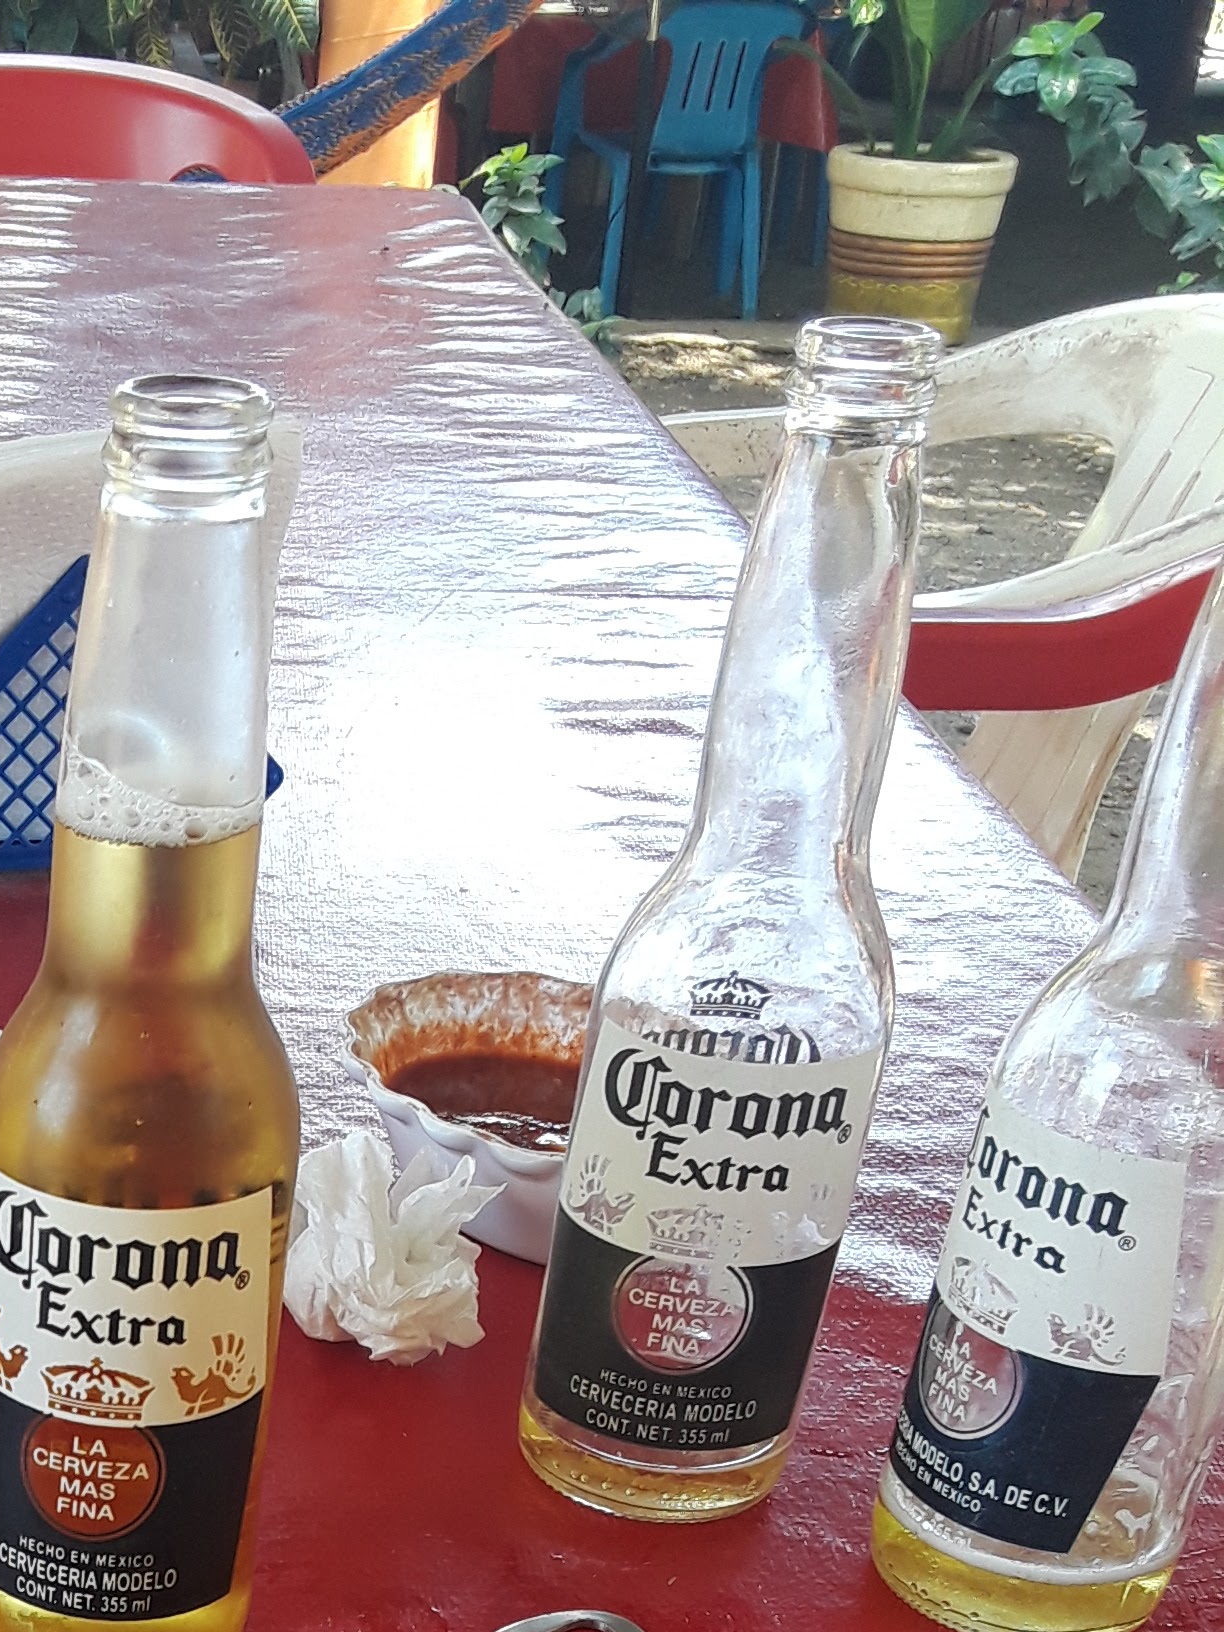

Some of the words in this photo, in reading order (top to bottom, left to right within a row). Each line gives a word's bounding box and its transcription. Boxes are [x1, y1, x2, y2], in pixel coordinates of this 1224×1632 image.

[604, 1049, 849, 1141] Corona
[644, 1131, 790, 1193] Extra
[967, 1105, 1129, 1237] orona
[962, 1185, 1067, 1275] Extra
[628, 1287, 736, 1317] CERVEZA
[668, 1276, 701, 1296] LA
[36, 1280, 187, 1347] Extra
[646, 1332, 700, 1356] FINA
[928, 1333, 999, 1396] CERVEZA
[569, 1374, 677, 1421] CERVECERIA
[683, 1400, 757, 1423] MODELO
[599, 1368, 648, 1393] HECHO
[652, 1383, 673, 1396] EN
[676, 1386, 732, 1399] MEXICO
[935, 1366, 970, 1402] MAS
[929, 1384, 966, 1421] FINA
[585, 1408, 632, 1436] CONT.
[636, 1423, 673, 1443] NET.
[678, 1428, 707, 1445] 355
[709, 1428, 730, 1443] ml
[32, 1446, 150, 1480] CERVEZA
[72, 1435, 108, 1458] LA
[58, 1475, 116, 1501] MAS
[911, 1430, 966, 1489] MODELO,
[1004, 1484, 1033, 1510] DE
[1033, 1493, 1070, 1518] C.V.
[56, 1496, 114, 1522] FINA
[932, 1477, 982, 1513] MEXICO
[18, 1534, 66, 1560] HECHO
[70, 1550, 90, 1565] EN
[95, 1554, 155, 1568] MEXICO
[16, 1575, 58, 1605] CONT.
[62, 1590, 96, 1612] NET.
[100, 1595, 127, 1613] 355
[131, 1594, 152, 1613] ml
[101, 1568, 178, 1593] MODELO
